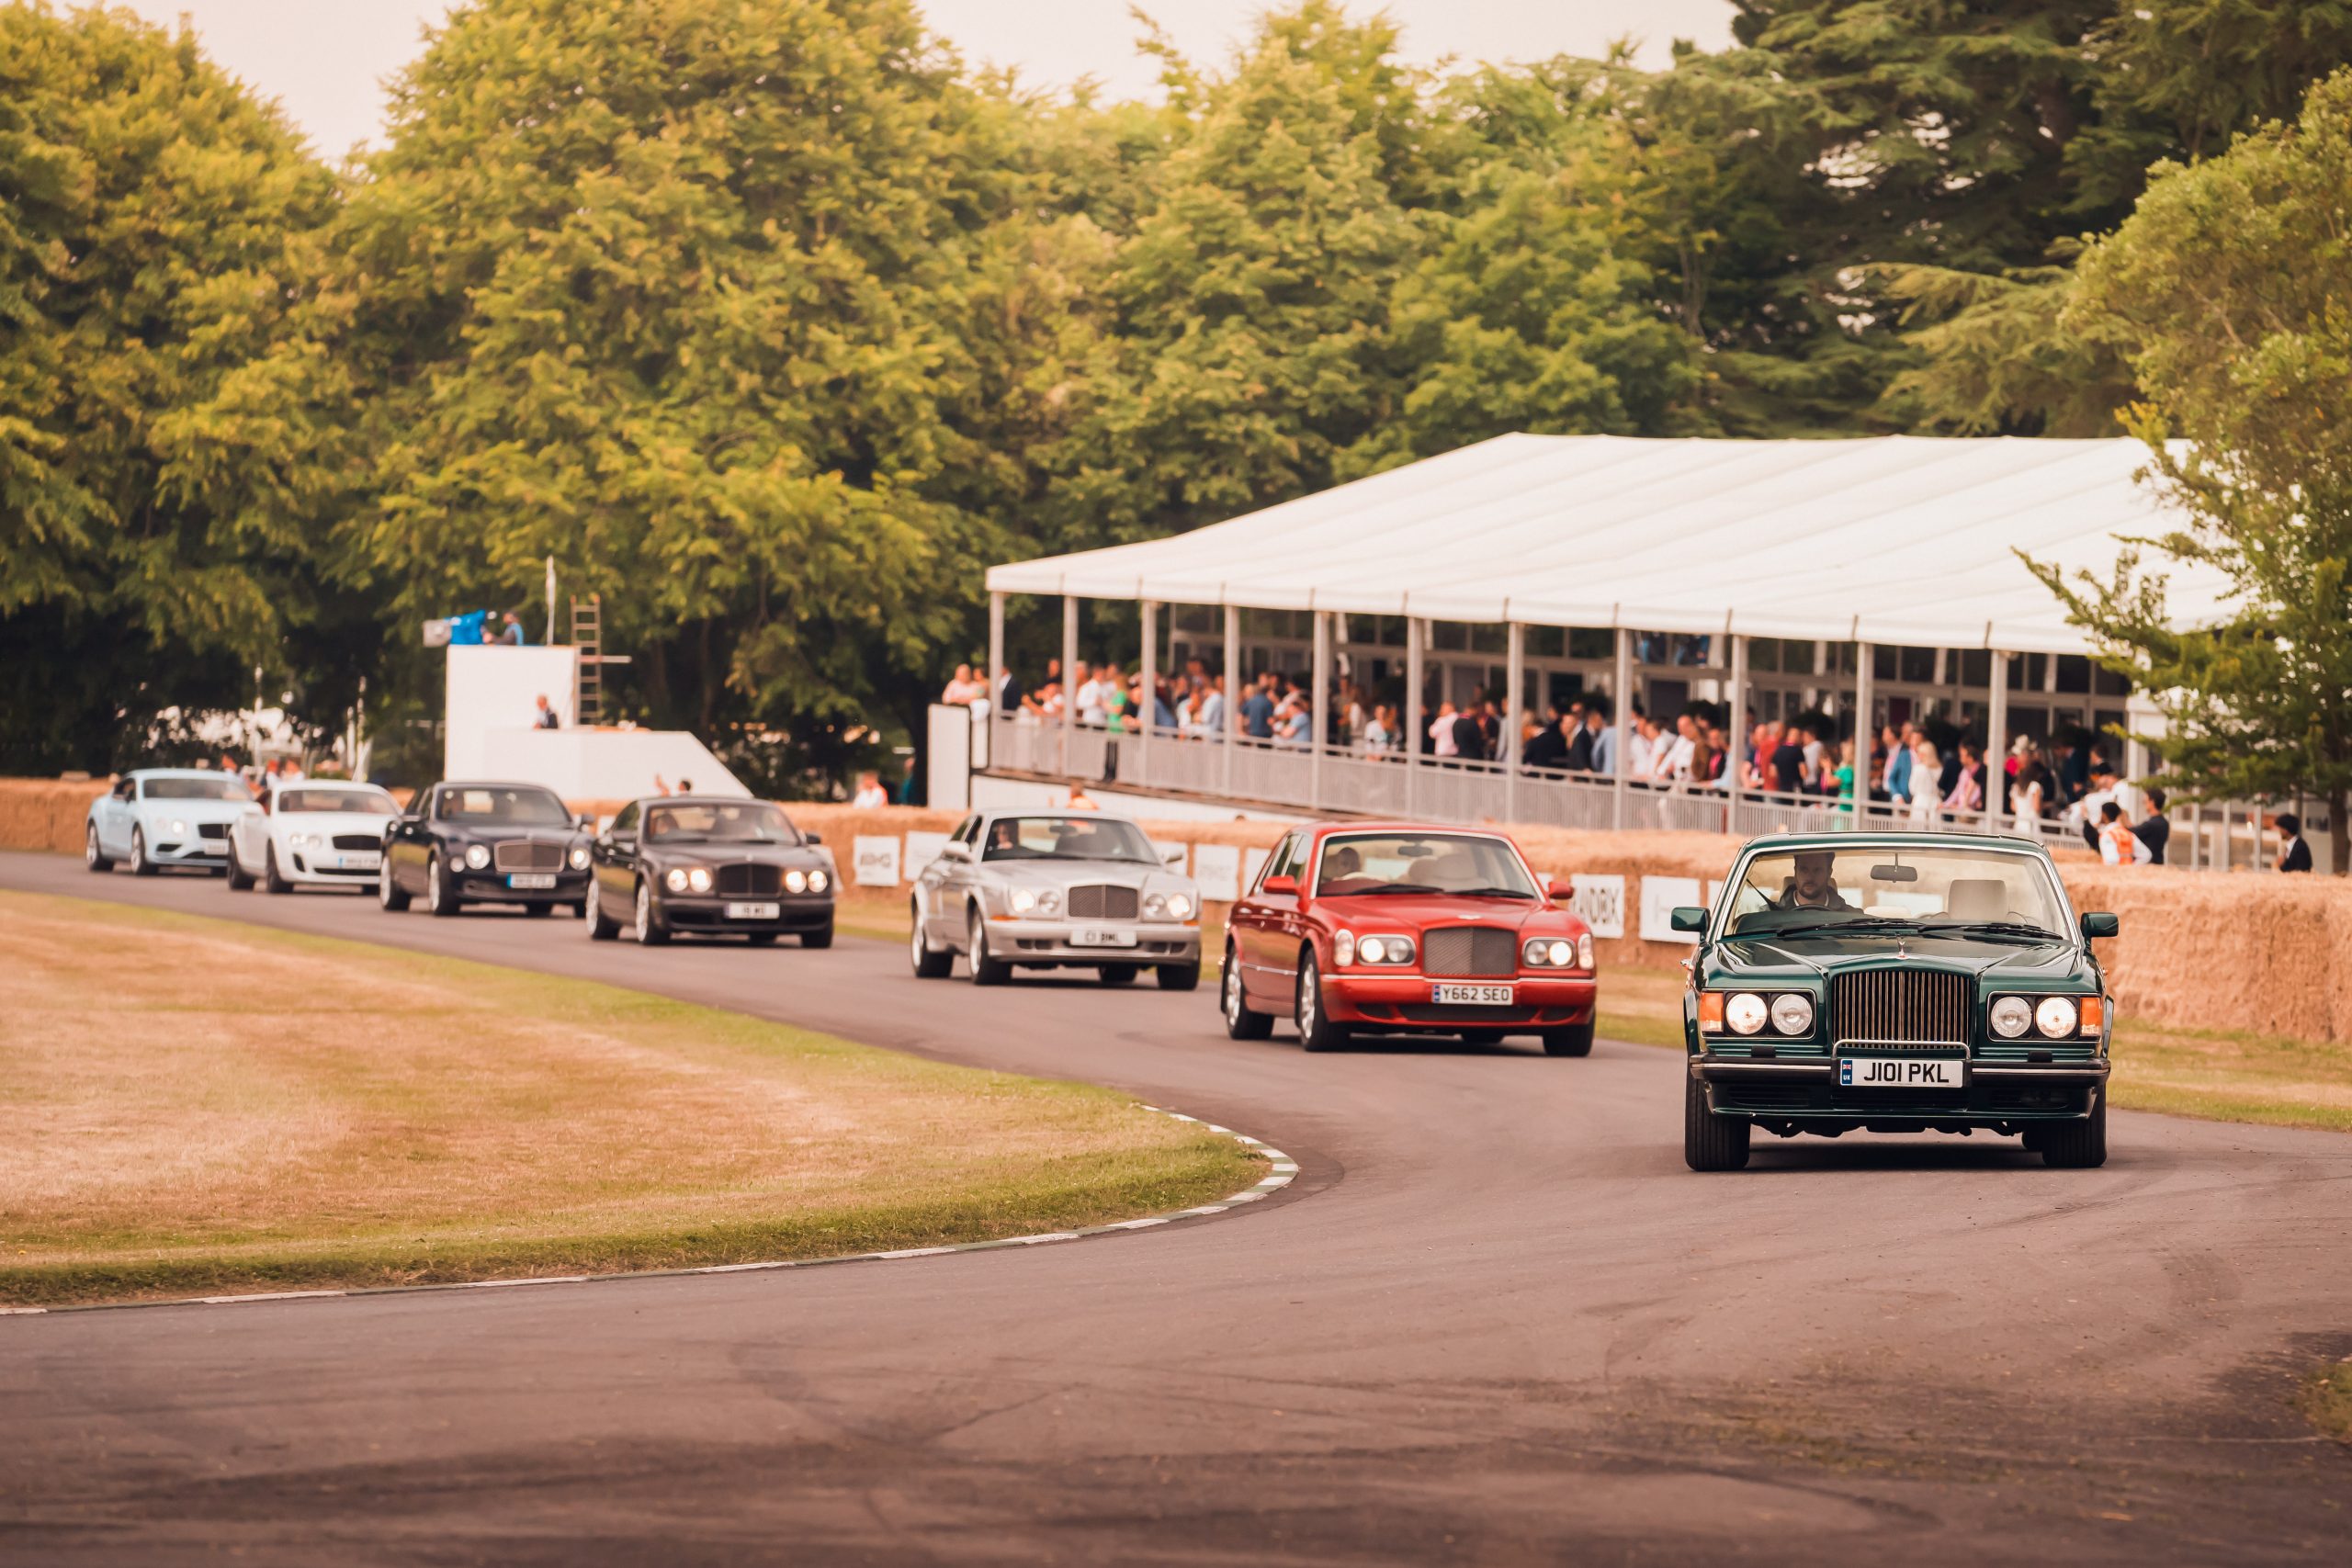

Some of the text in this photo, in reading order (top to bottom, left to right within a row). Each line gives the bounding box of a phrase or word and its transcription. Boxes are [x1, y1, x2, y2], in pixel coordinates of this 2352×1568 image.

[1443, 987, 1510, 1001] Y662 SEO
[1863, 1062, 1950, 1084] J101 PKL
